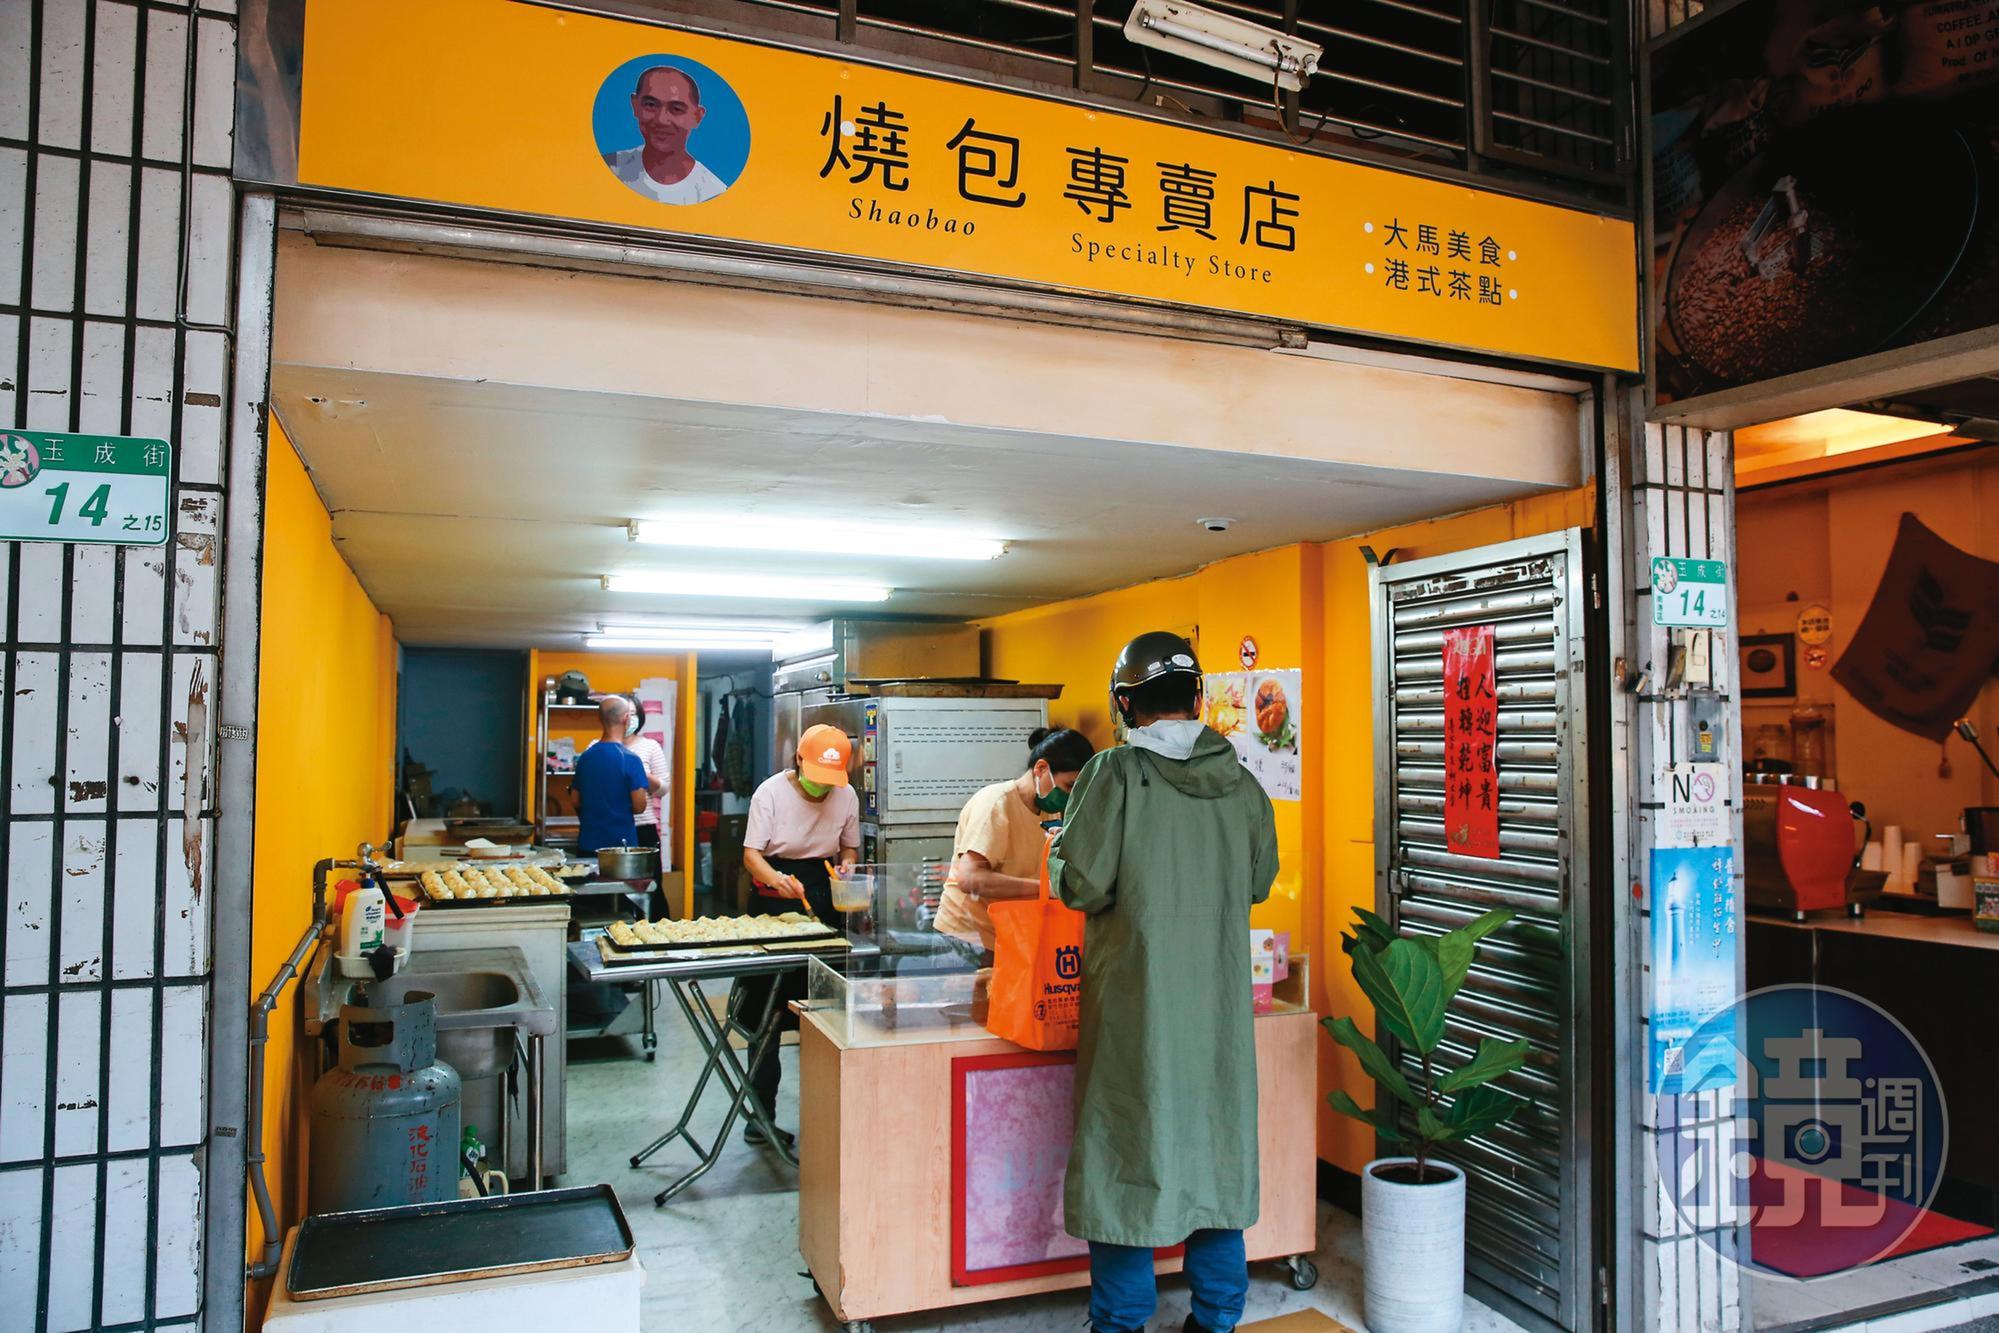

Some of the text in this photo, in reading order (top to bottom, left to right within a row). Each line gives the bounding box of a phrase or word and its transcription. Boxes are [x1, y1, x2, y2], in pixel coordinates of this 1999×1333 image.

[1936, 14, 1982, 33] COFFEE
[848, 197, 1272, 284] Shaobao Specialty Store
[1383, 217, 1502, 267] 大馬美食
[1384, 257, 1502, 306] 港式茶點
[42, 438, 165, 468] 玉成街
[45, 482, 112, 527] 14
[122, 514, 163, 531] 之15
[1680, 589, 1705, 617] 14
[1474, 673, 1494, 812] 人迎富貴
[408, 1124, 432, 1198] 液化石油
